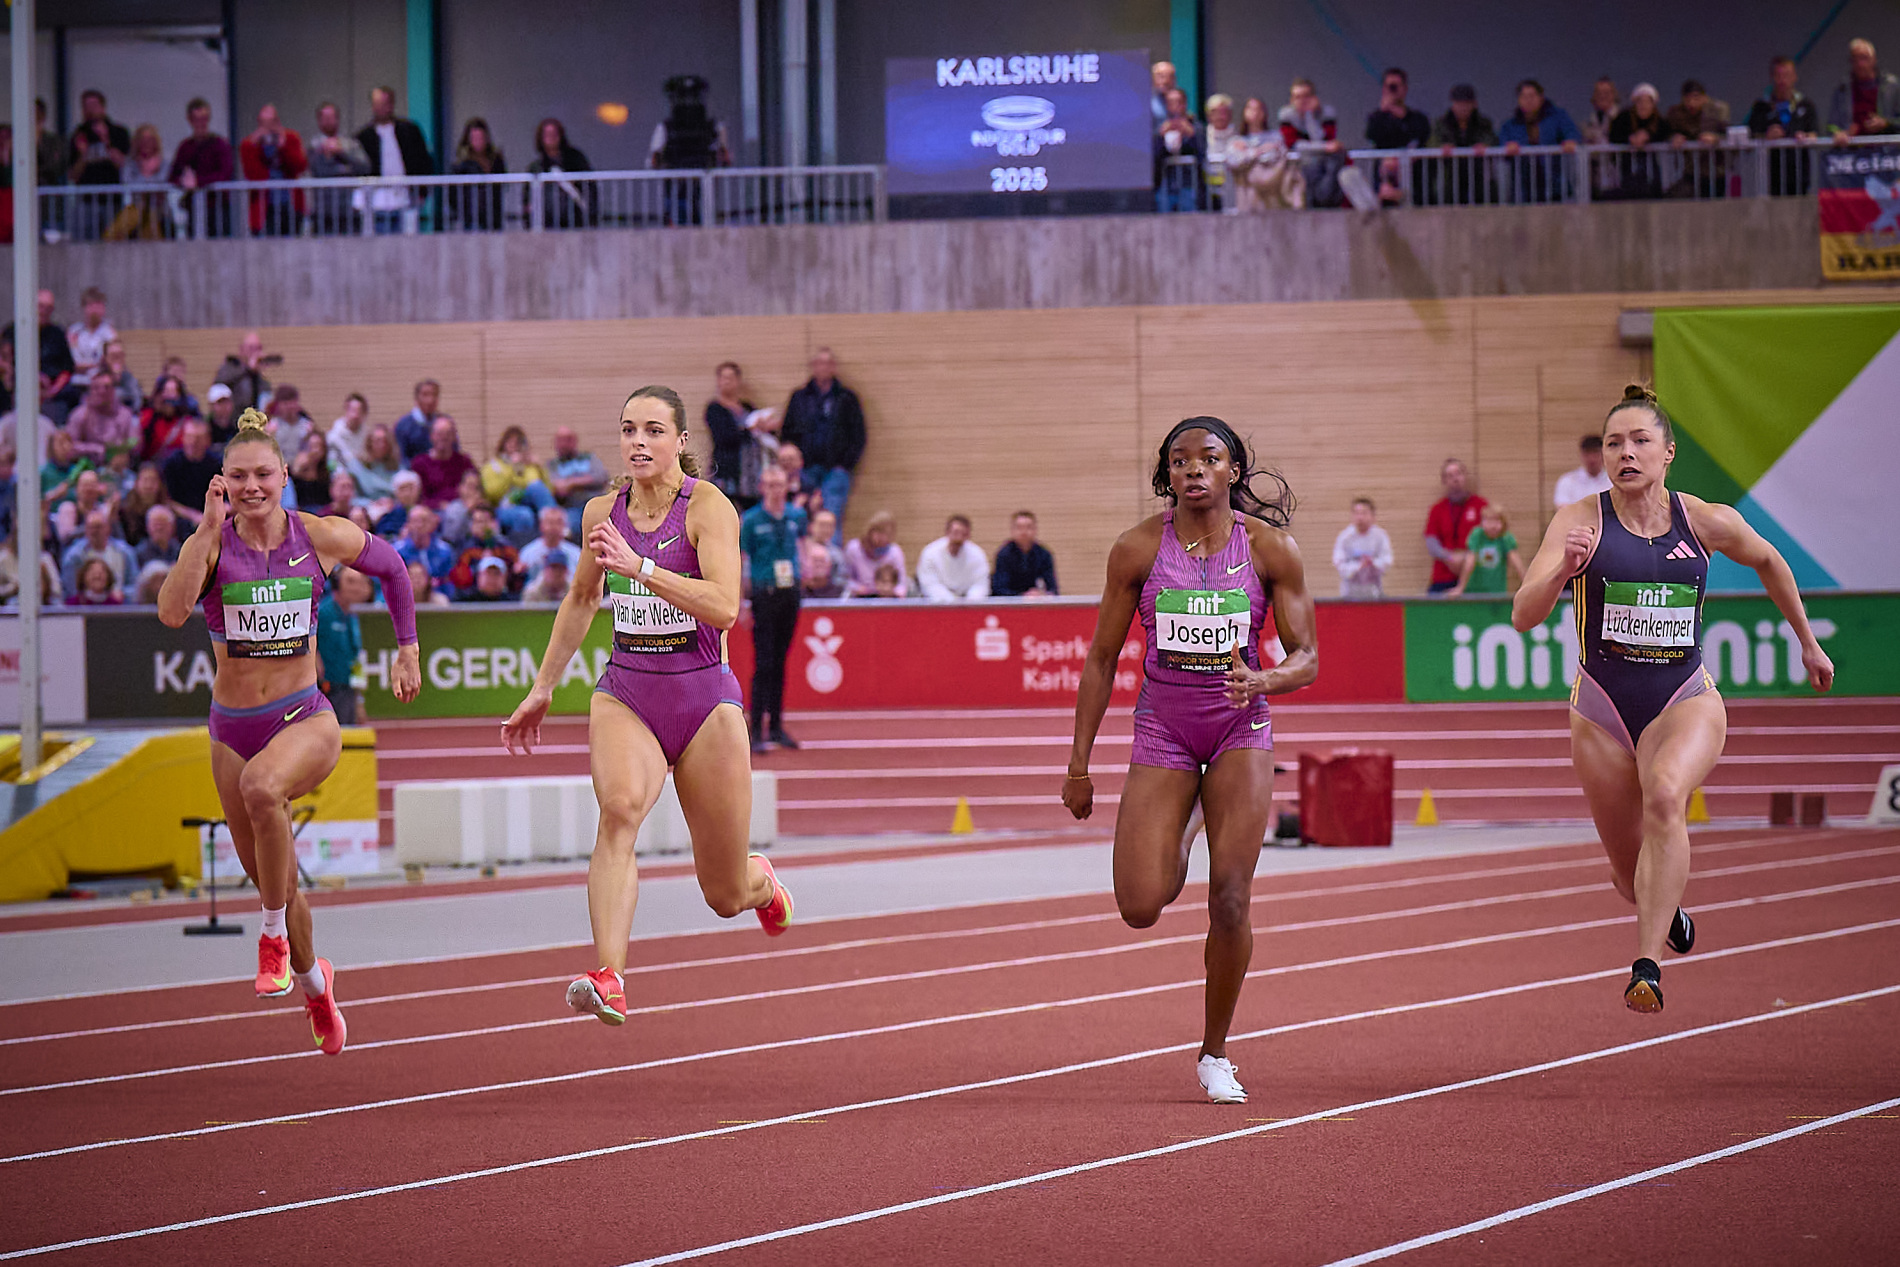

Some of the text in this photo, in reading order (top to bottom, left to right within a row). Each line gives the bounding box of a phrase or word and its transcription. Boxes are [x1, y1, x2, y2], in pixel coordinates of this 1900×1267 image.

[937, 53, 1100, 87] KARLSRUHE
[252, 580, 287, 603] init
[1187, 592, 1225, 615] init
[1637, 585, 1674, 606] init
[238, 610, 300, 639] Mayer
[612, 598, 630, 624] Van
[632, 601, 647, 626] der
[1167, 619, 1239, 652] Joseph
[1606, 609, 1692, 645] Lückenkemper
[645, 639, 664, 647] TOUR
[664, 636, 688, 645] GOLD
[1021, 635, 1142, 664] Sparke
[1642, 650, 1662, 658] TOUR
[1702, 619, 1837, 687] nit
[1198, 657, 1220, 665] TOUR
[1221, 656, 1233, 664] GO
[1022, 665, 1137, 691] Karlse
